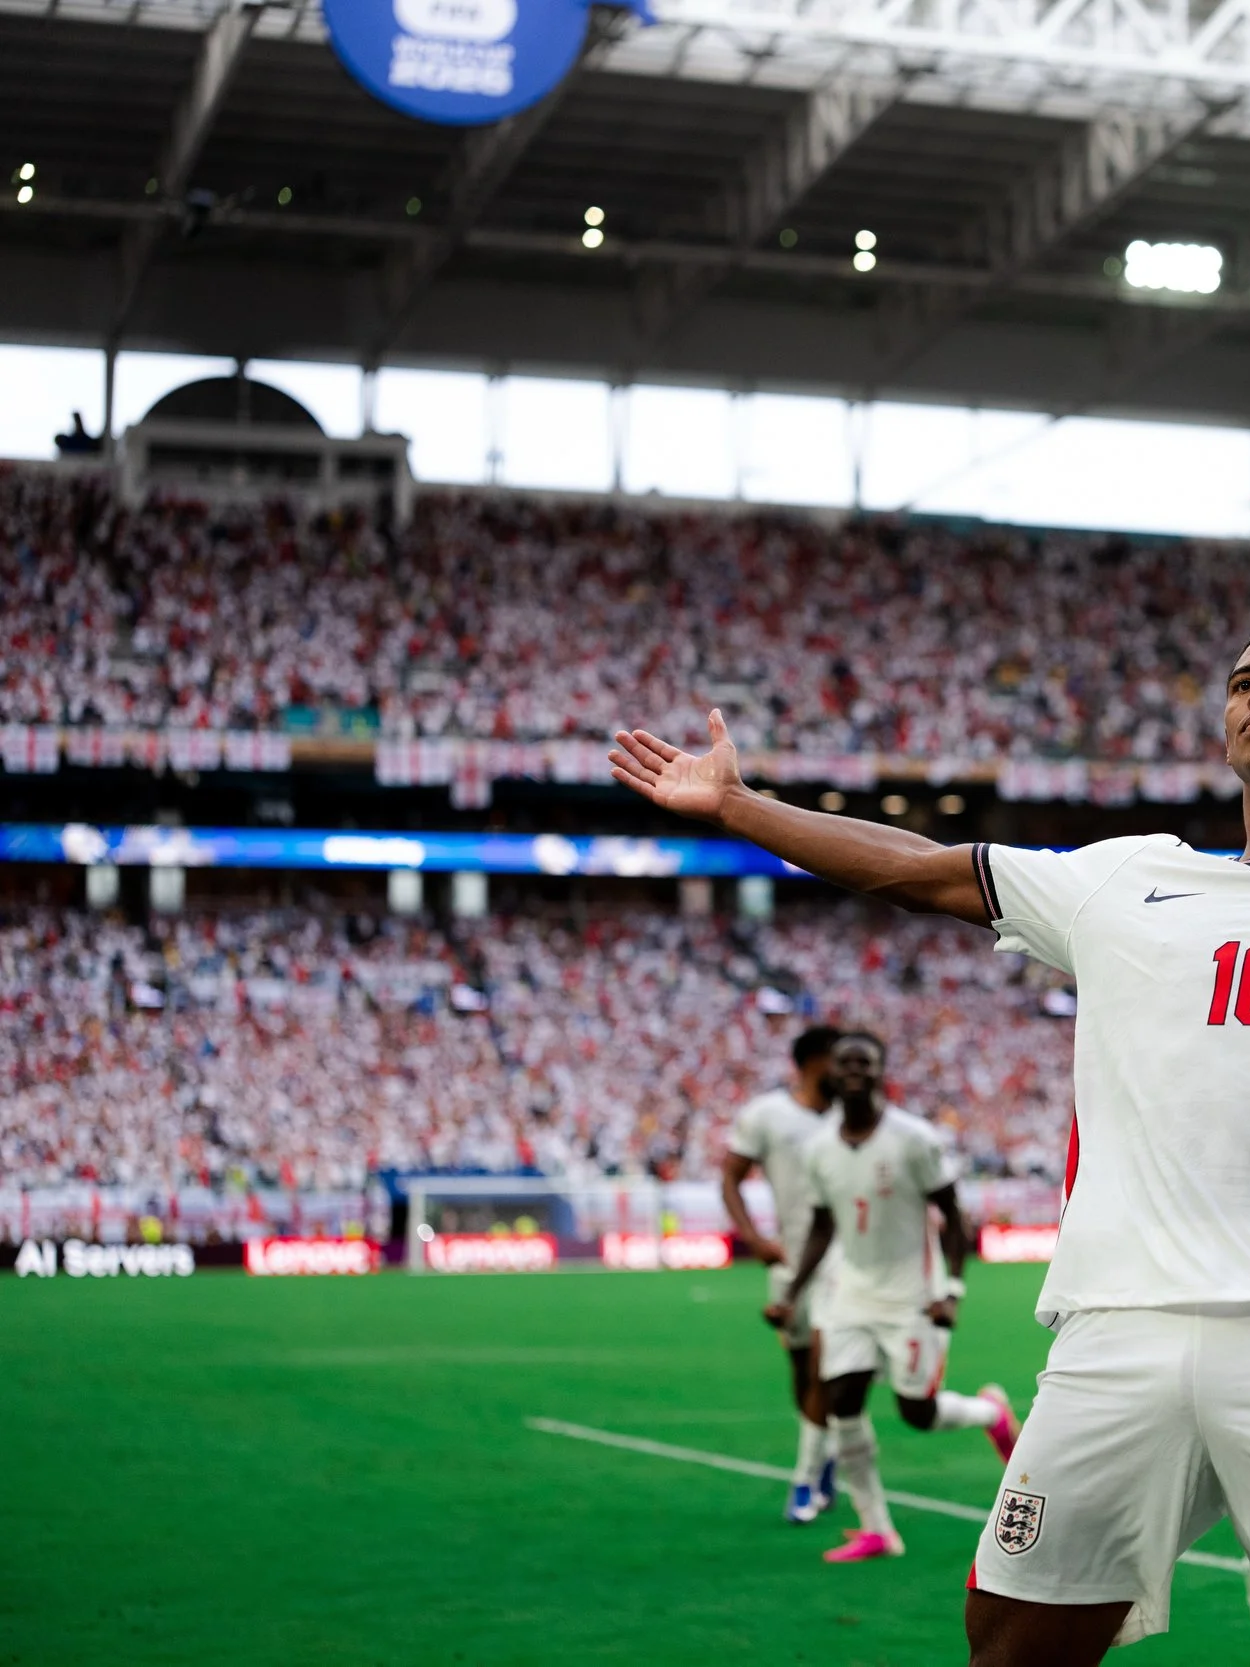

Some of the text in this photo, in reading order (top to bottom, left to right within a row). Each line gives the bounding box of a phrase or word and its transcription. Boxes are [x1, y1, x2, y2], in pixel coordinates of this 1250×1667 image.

[854, 1197, 870, 1235] 7
[15, 1239, 195, 1278] AI Servers
[906, 1338, 921, 1374] 7
